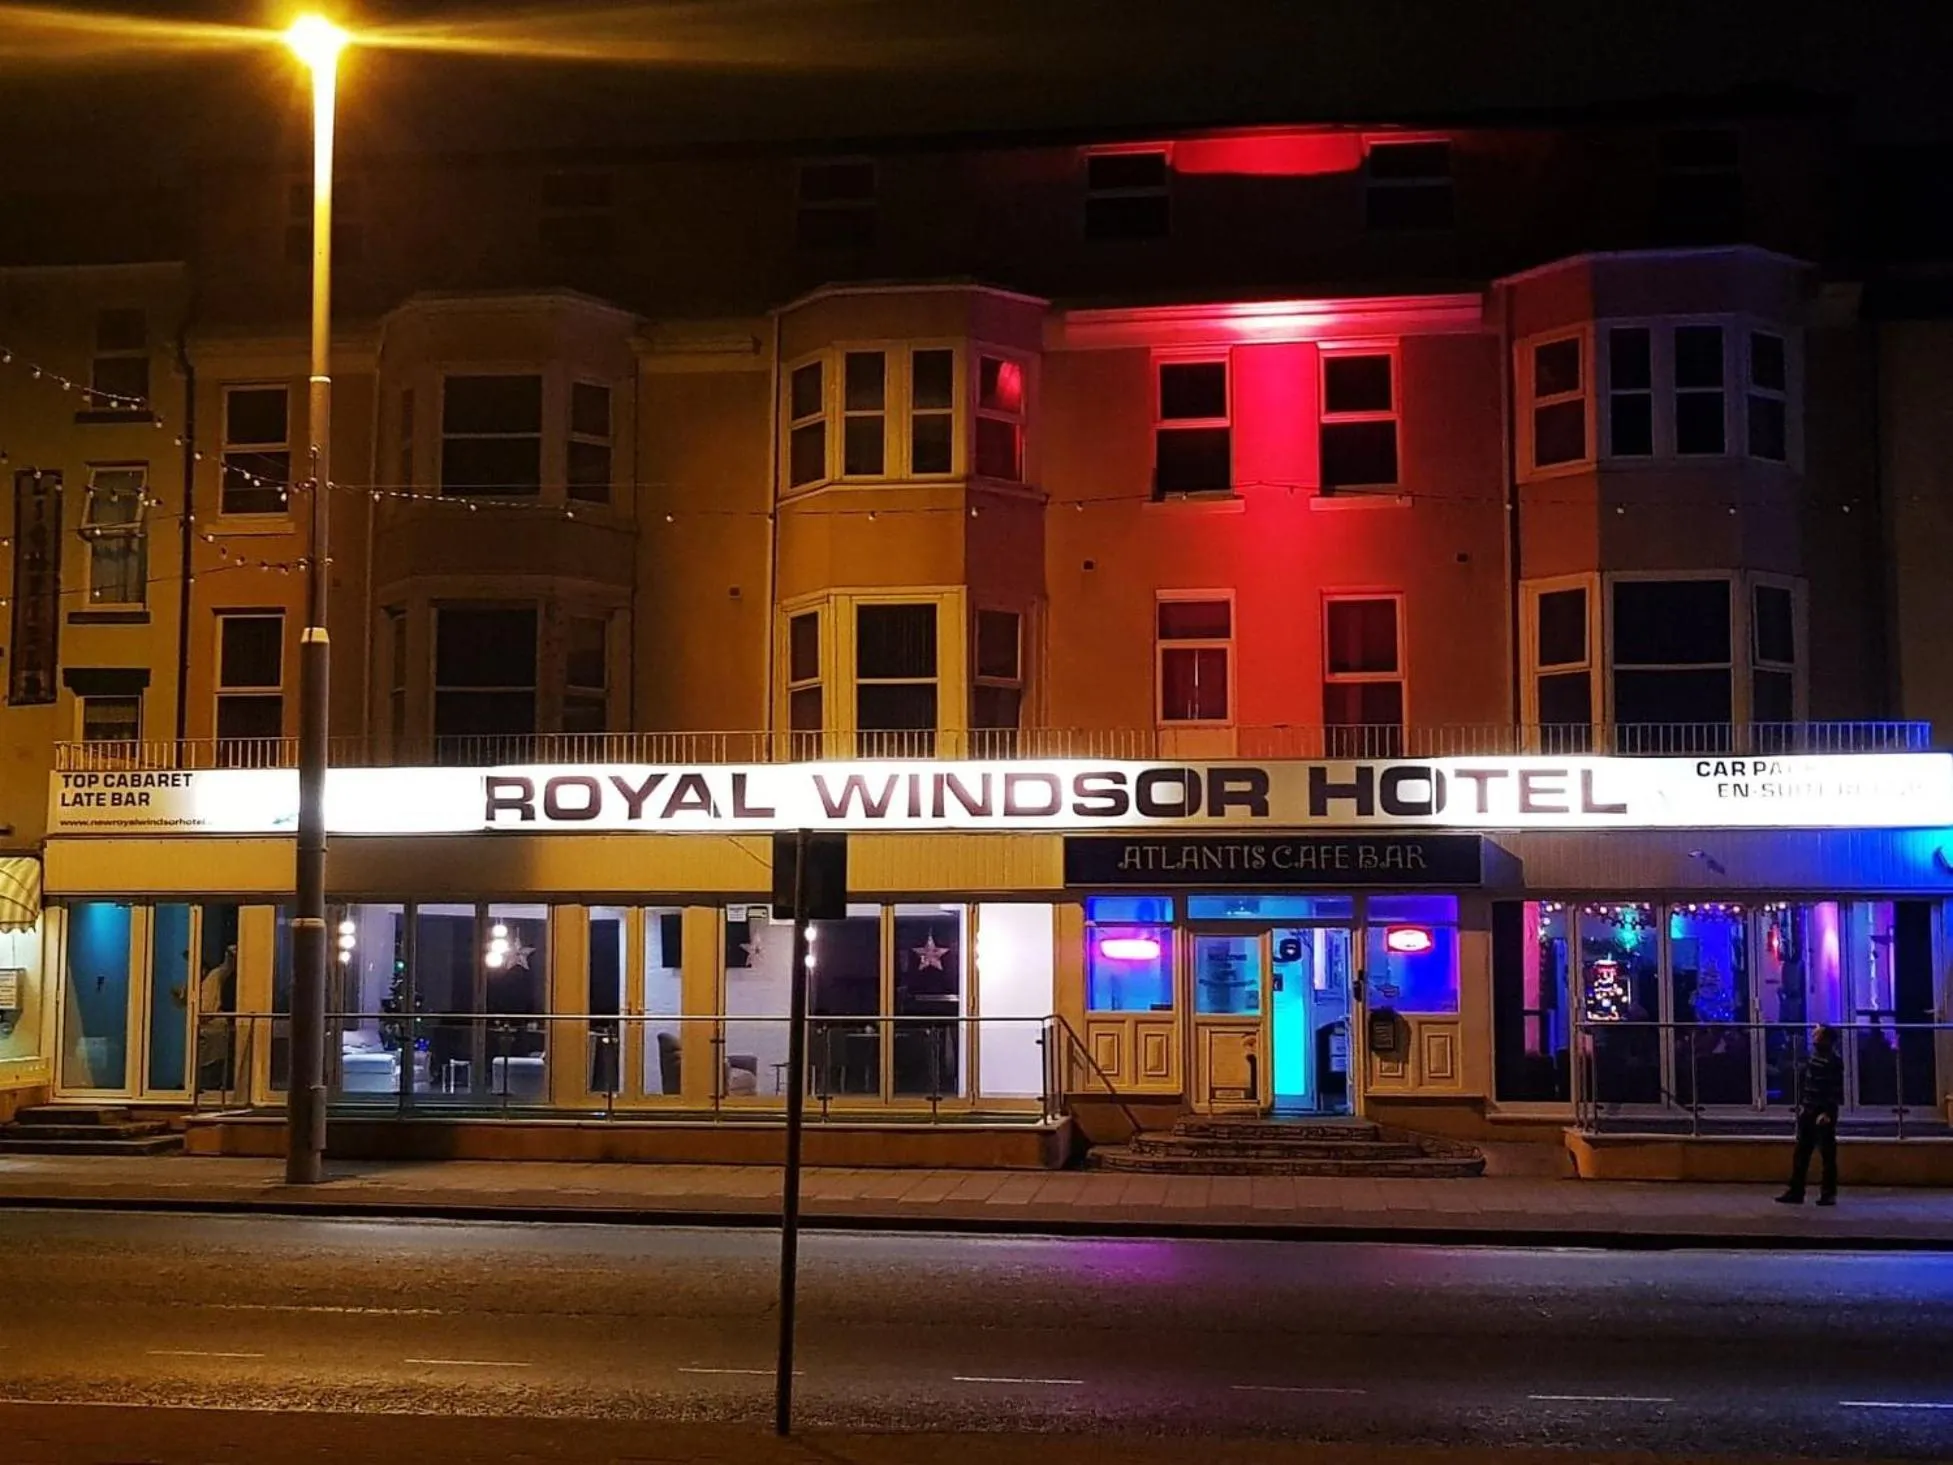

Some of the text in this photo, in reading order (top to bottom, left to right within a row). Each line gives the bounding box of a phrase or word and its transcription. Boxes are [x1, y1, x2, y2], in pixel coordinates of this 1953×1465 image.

[1695, 759, 1748, 779] CAR
[62, 773, 194, 788] TOP CABARET
[60, 792, 150, 807] LATE BAR
[483, 765, 1628, 822] ROYAL WINDSOR HOTEL
[1117, 844, 1428, 870] ATLANTIS CAFE BAR
